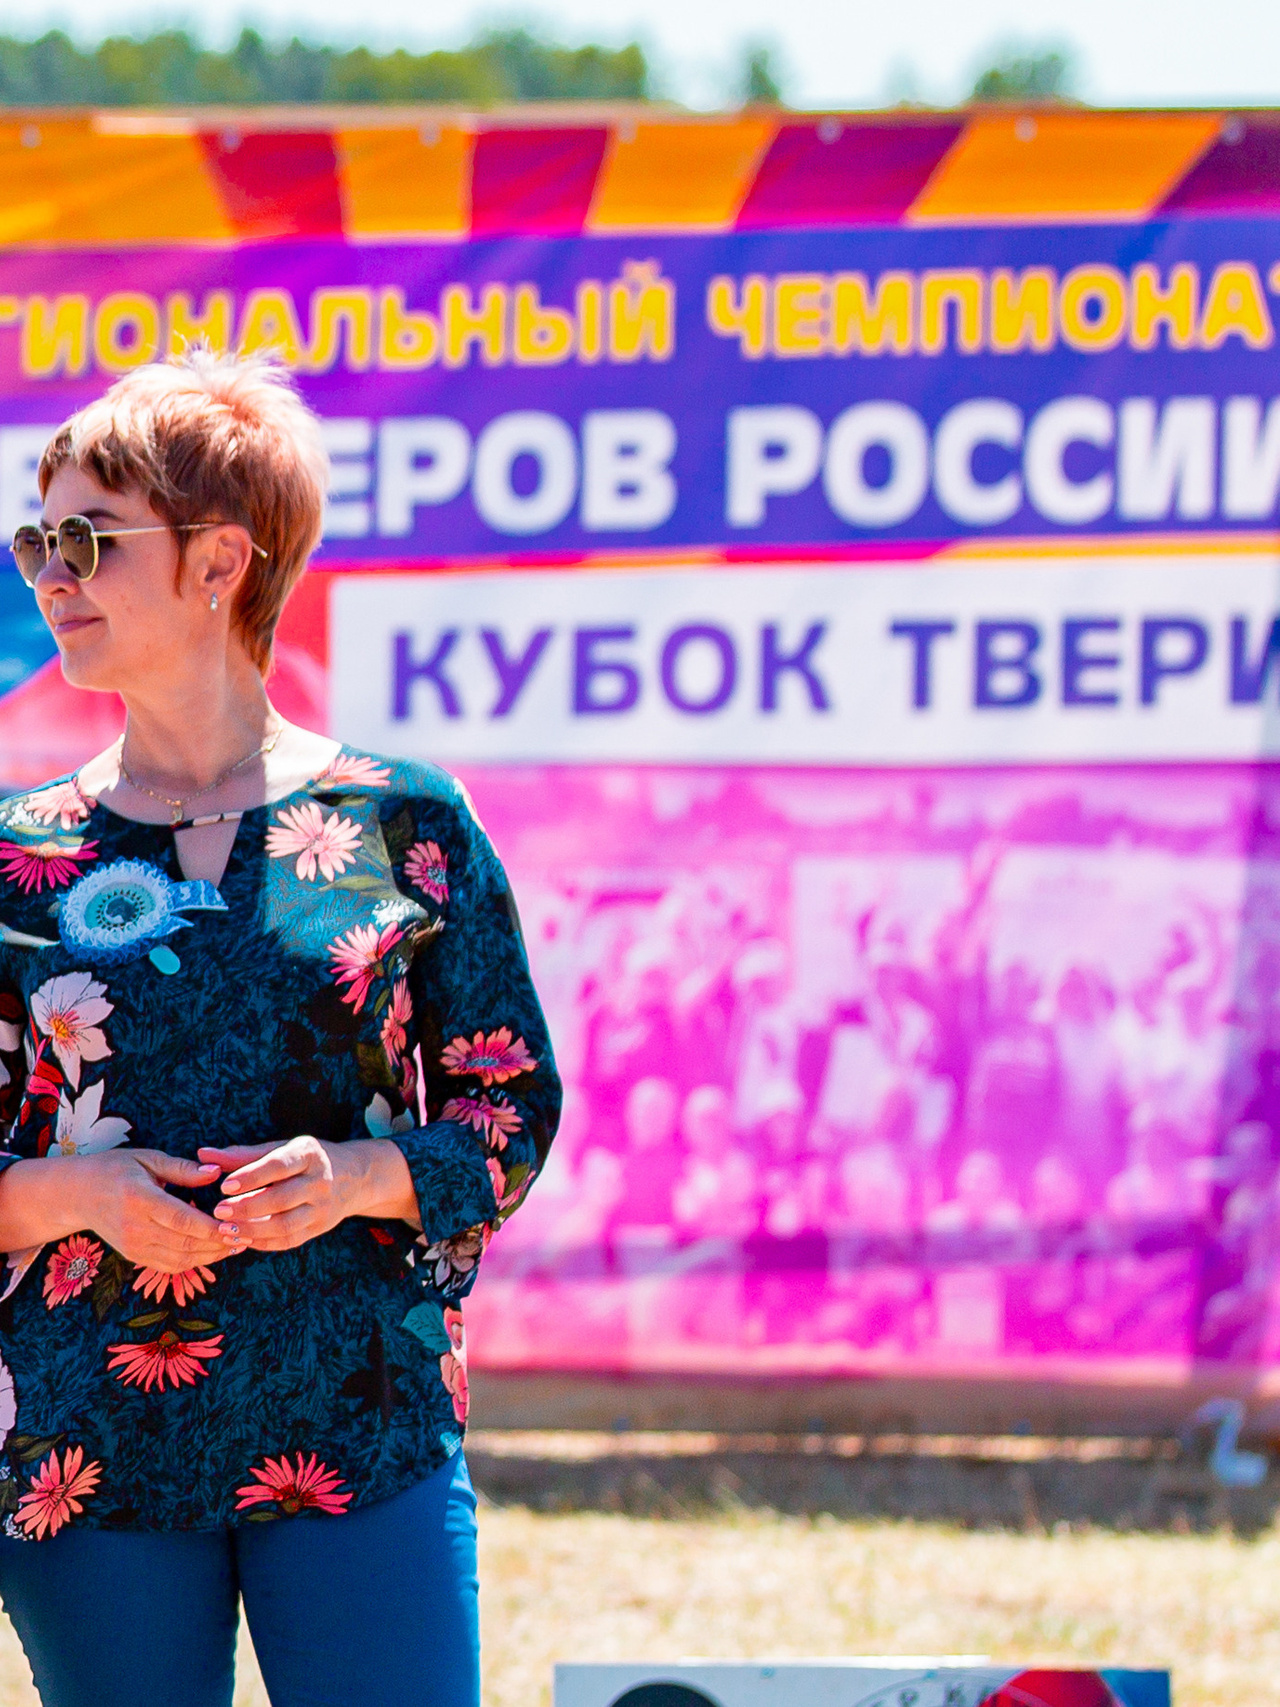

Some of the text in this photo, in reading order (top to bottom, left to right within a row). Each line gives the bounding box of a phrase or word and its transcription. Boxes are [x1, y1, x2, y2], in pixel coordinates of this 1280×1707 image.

[706, 262, 1280, 360] ЧЕМПИОНА
[725, 394, 1280, 529] РОССИИ
[389, 613, 1280, 724] КУБОК ТВЕРИ
